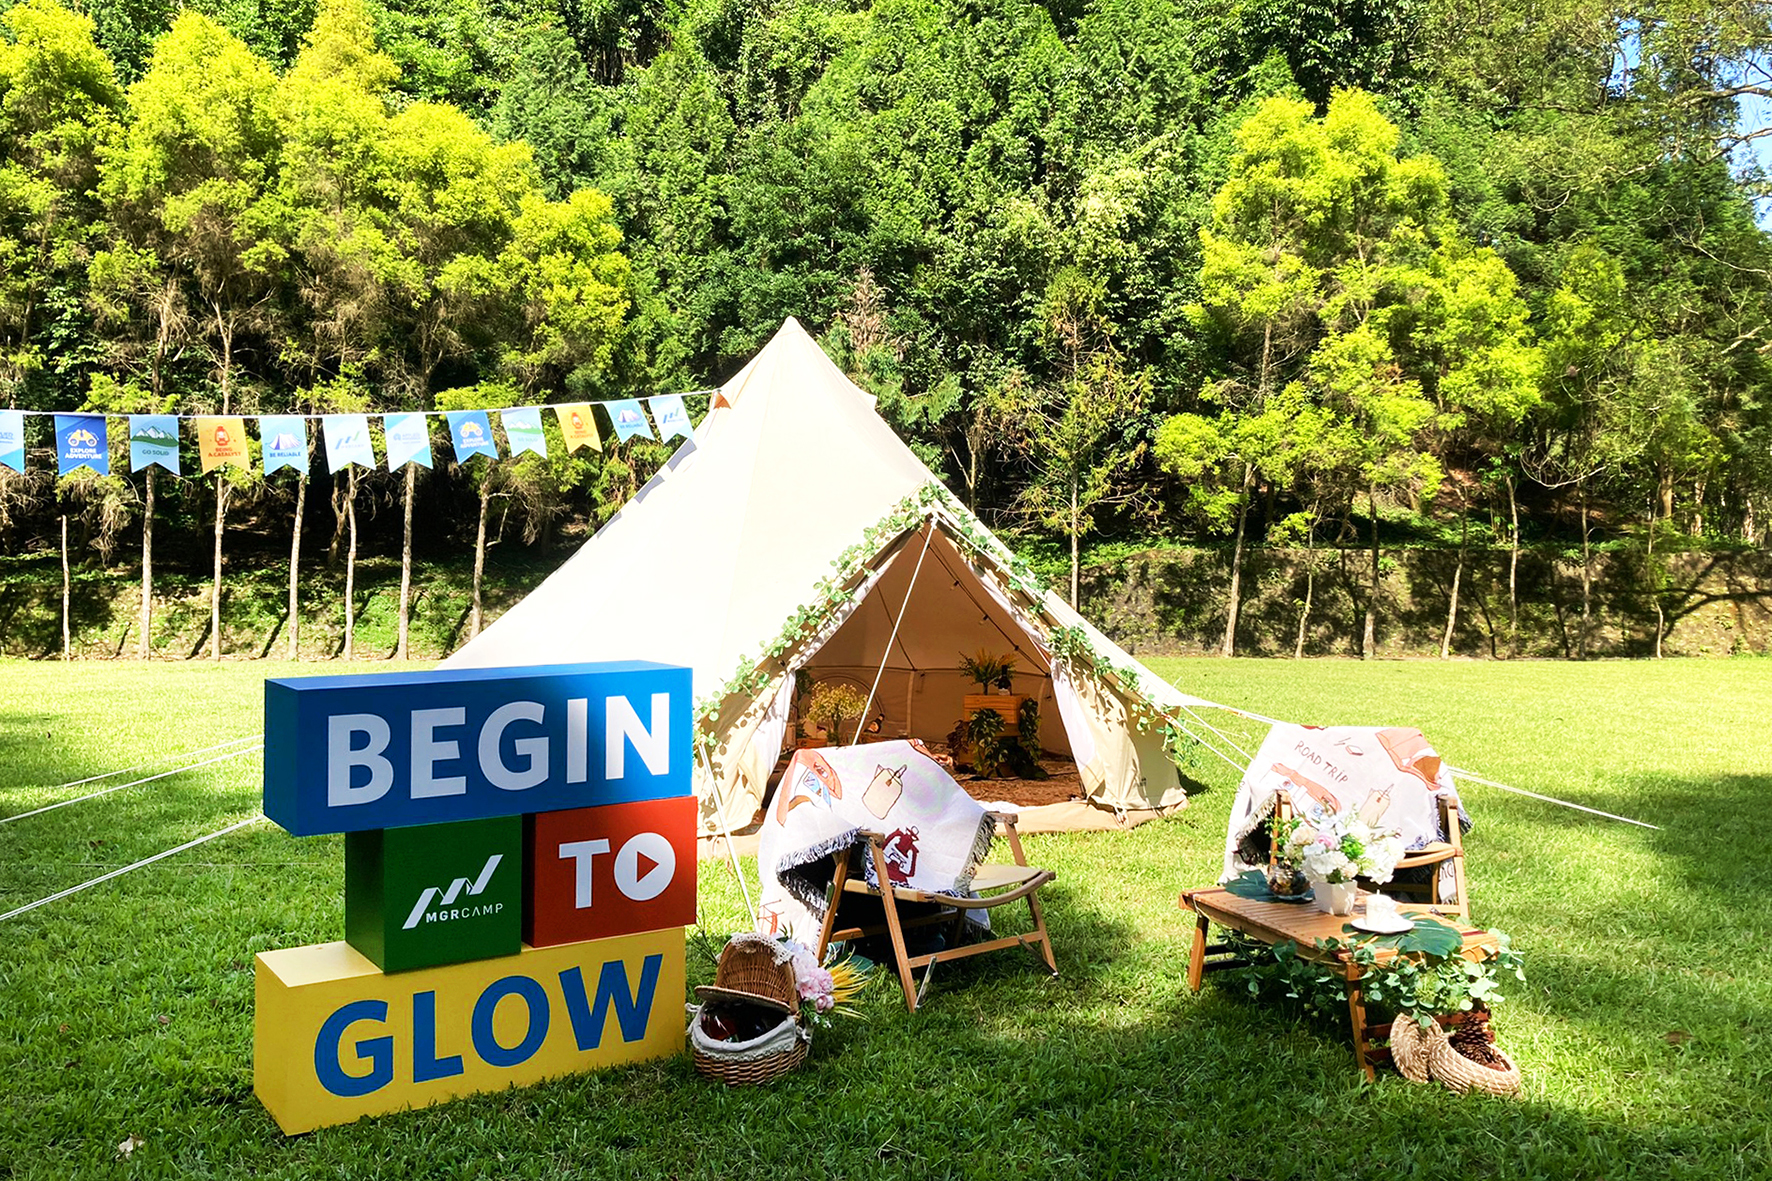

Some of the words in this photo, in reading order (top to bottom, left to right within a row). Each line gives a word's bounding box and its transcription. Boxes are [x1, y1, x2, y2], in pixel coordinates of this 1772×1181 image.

[327, 692, 671, 808] BEGIN
[1294, 740, 1322, 766] ROAD
[558, 831, 677, 910] TO
[425, 902, 504, 924] MGRCAMP
[313, 953, 664, 1098] GLOW
